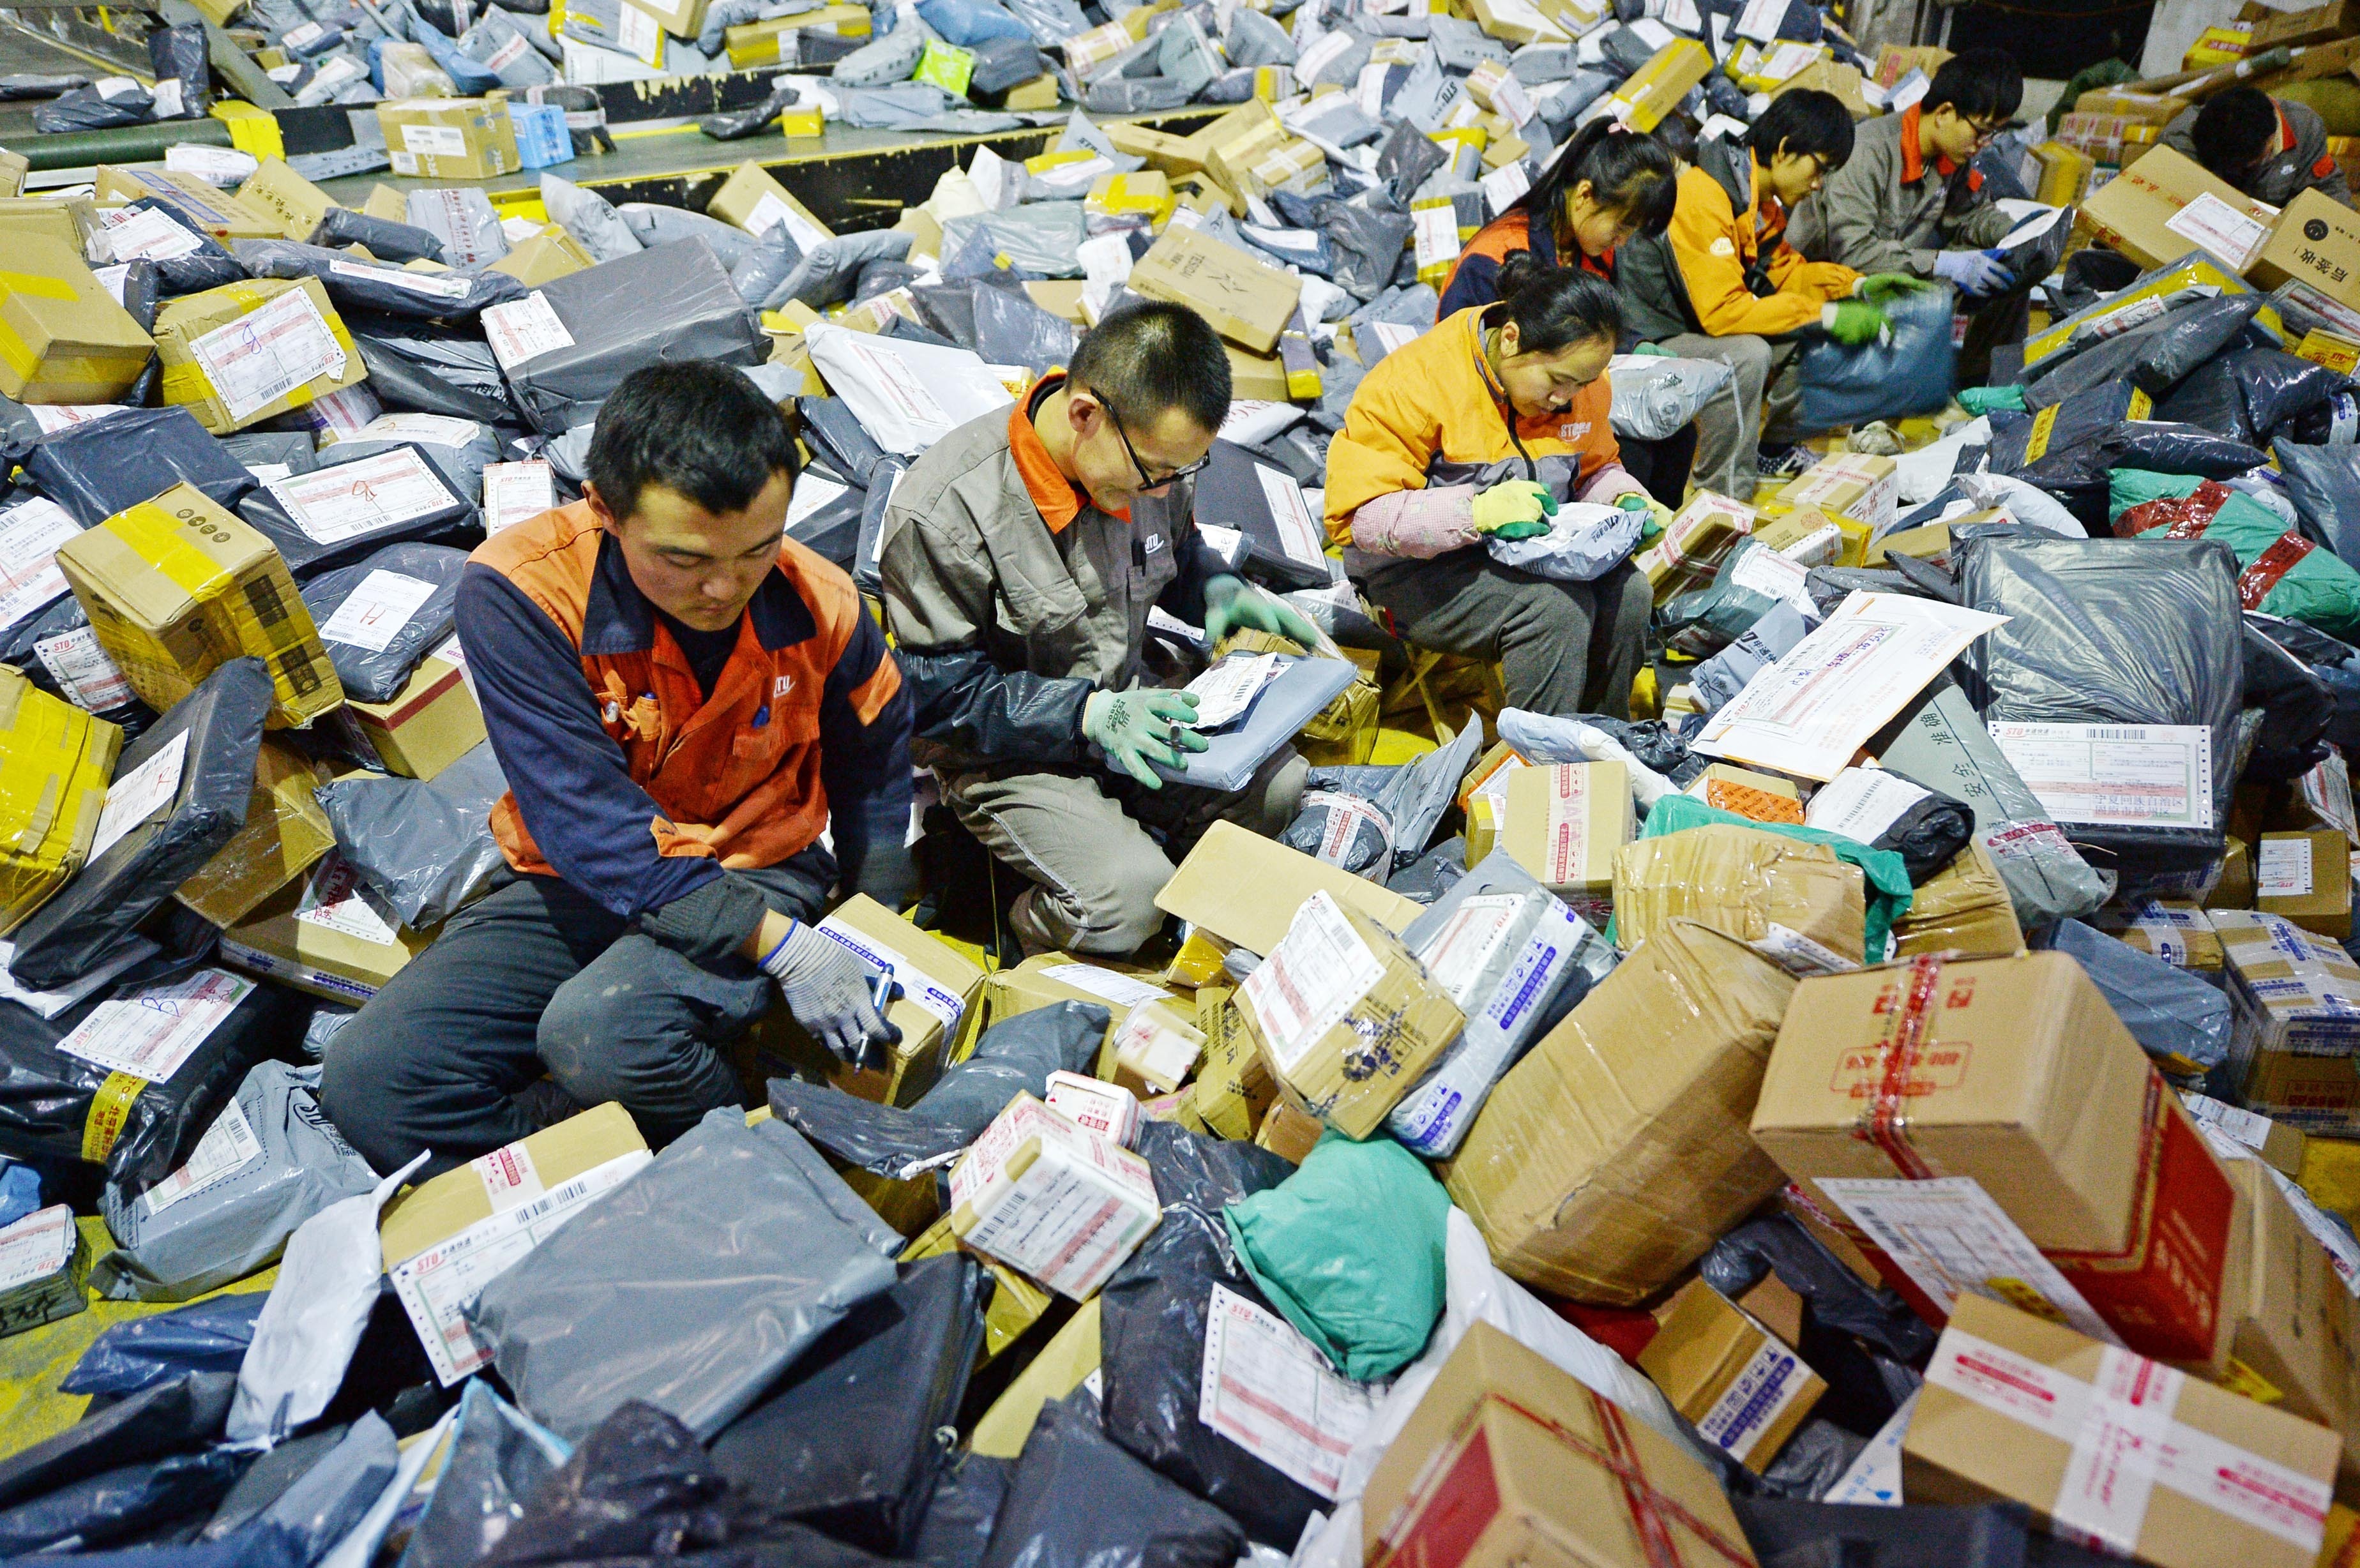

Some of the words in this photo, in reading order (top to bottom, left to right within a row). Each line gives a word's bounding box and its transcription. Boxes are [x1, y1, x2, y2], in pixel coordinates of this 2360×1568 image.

[1441, 81, 1458, 104] STO
[53, 640, 70, 651] STO
[1734, 704, 1745, 715] STO
[2094, 795, 2182, 806] 宁夏回族自治区
[74, 1030, 87, 1045] STO
[37, 1260, 57, 1270] STO
[416, 1252, 437, 1270] STO
[1231, 1304, 1252, 1317] STO
